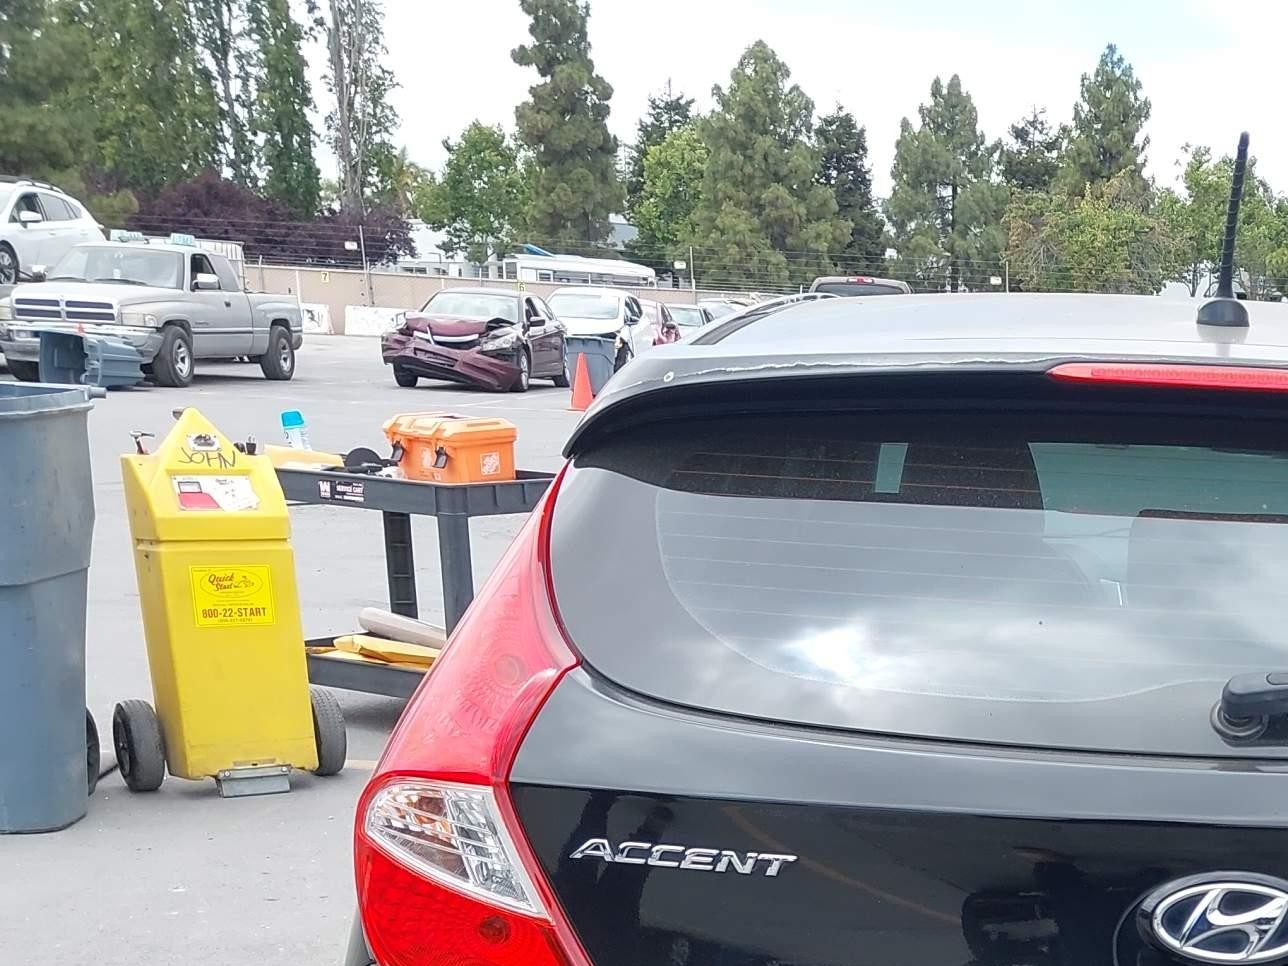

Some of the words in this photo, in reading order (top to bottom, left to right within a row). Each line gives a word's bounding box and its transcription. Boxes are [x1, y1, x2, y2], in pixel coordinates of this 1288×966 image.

[178, 447, 236, 469] JOHN
[208, 573, 235, 586] Quick
[202, 607, 266, 619] 800-22-START
[569, 838, 798, 877] ACCENT
